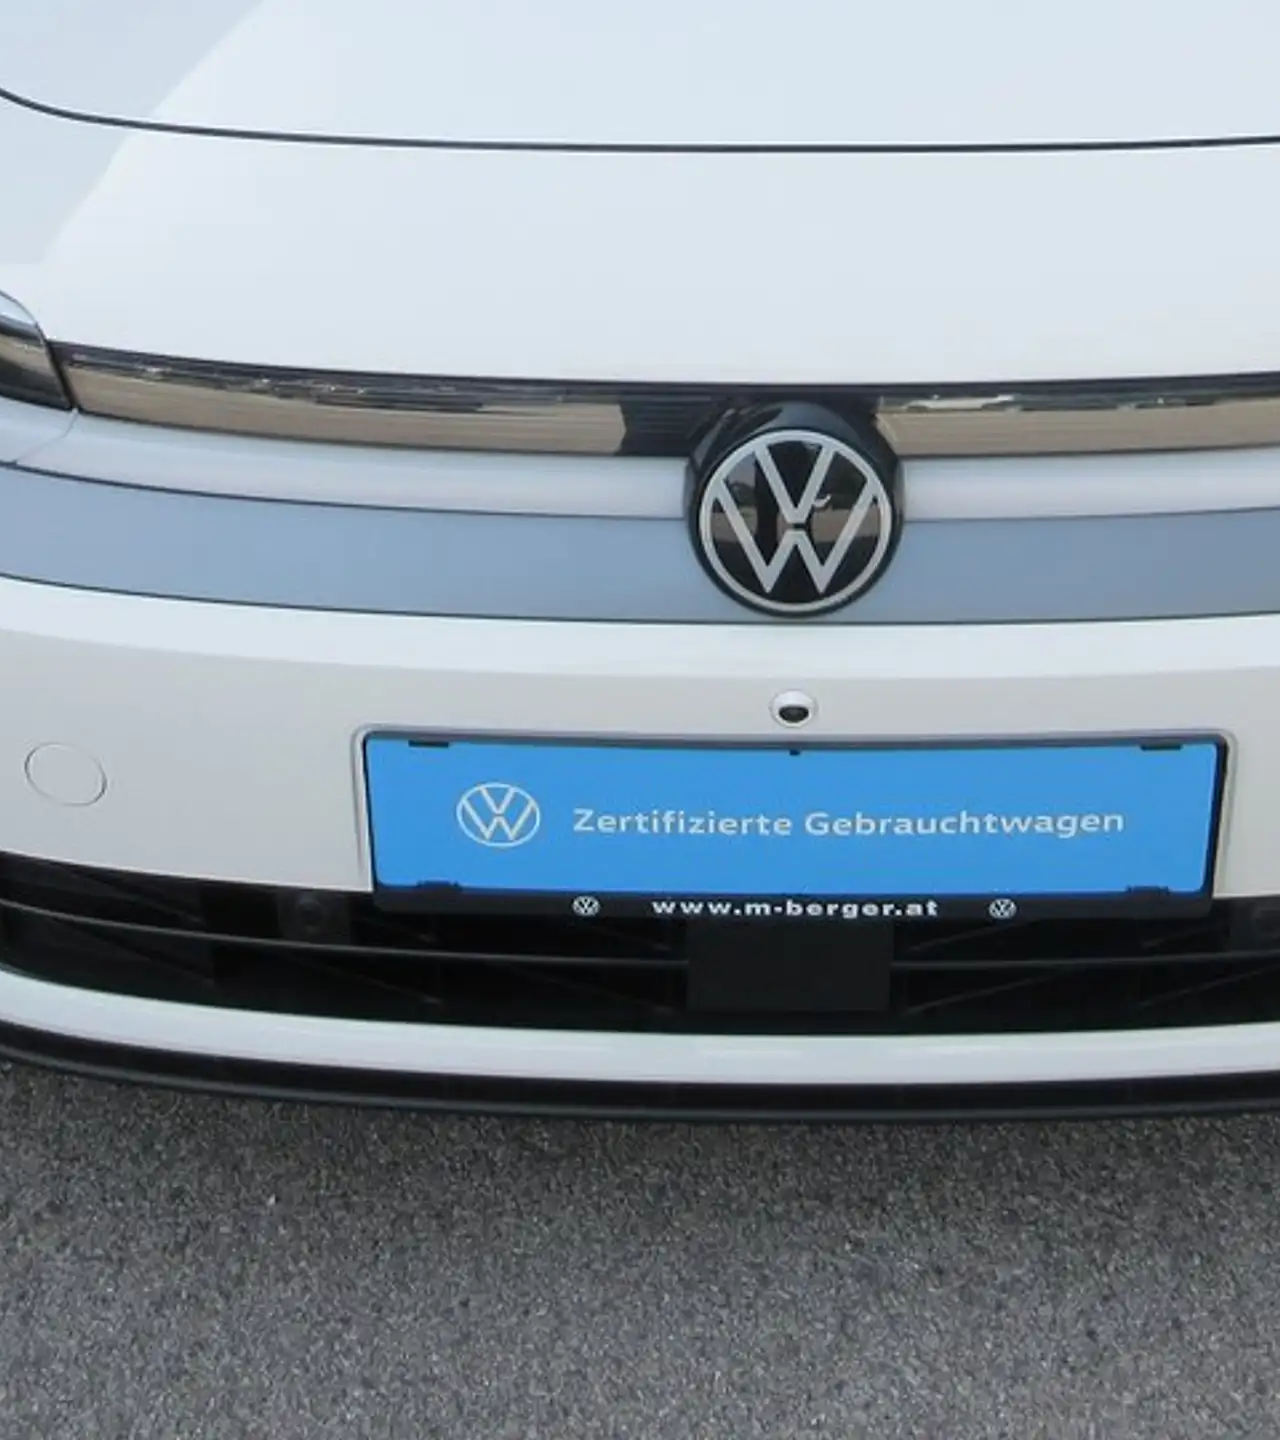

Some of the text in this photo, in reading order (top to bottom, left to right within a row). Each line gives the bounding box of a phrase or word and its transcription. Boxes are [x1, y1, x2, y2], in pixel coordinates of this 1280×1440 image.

[573, 807, 1125, 839] Zertifizierte Gebrauchtwagen
[652, 899, 939, 919] www.m-berger.at
